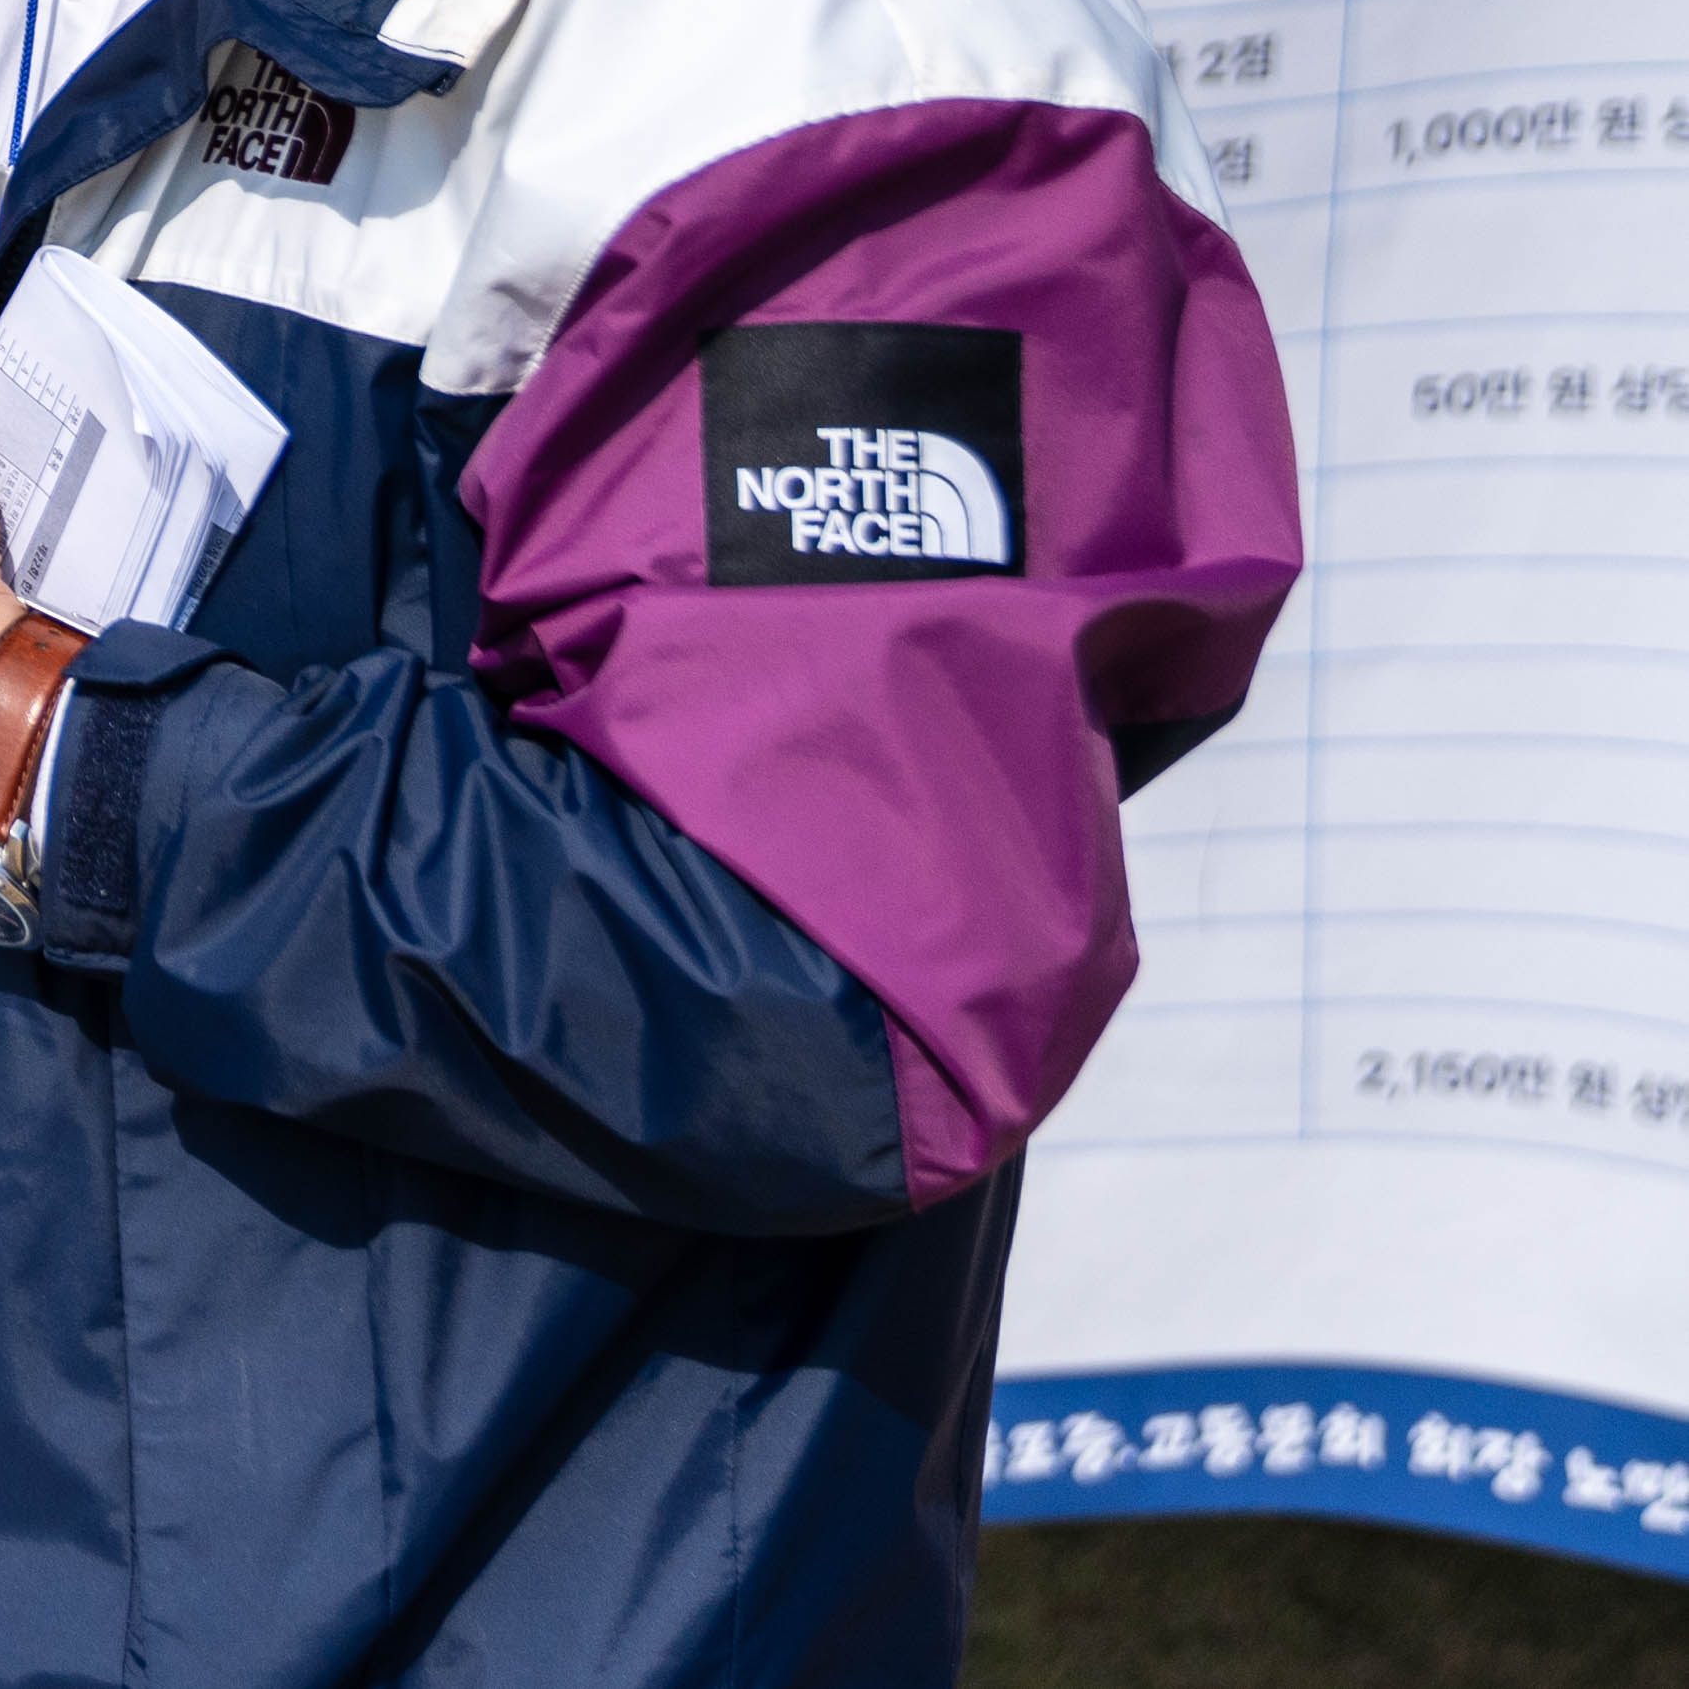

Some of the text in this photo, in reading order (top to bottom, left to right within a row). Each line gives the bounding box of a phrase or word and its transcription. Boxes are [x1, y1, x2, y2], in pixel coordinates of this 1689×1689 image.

[202, 125, 293, 175] FACE
[816, 427, 920, 471] THE
[736, 467, 921, 512] NORTH
[791, 510, 923, 557] FACE
